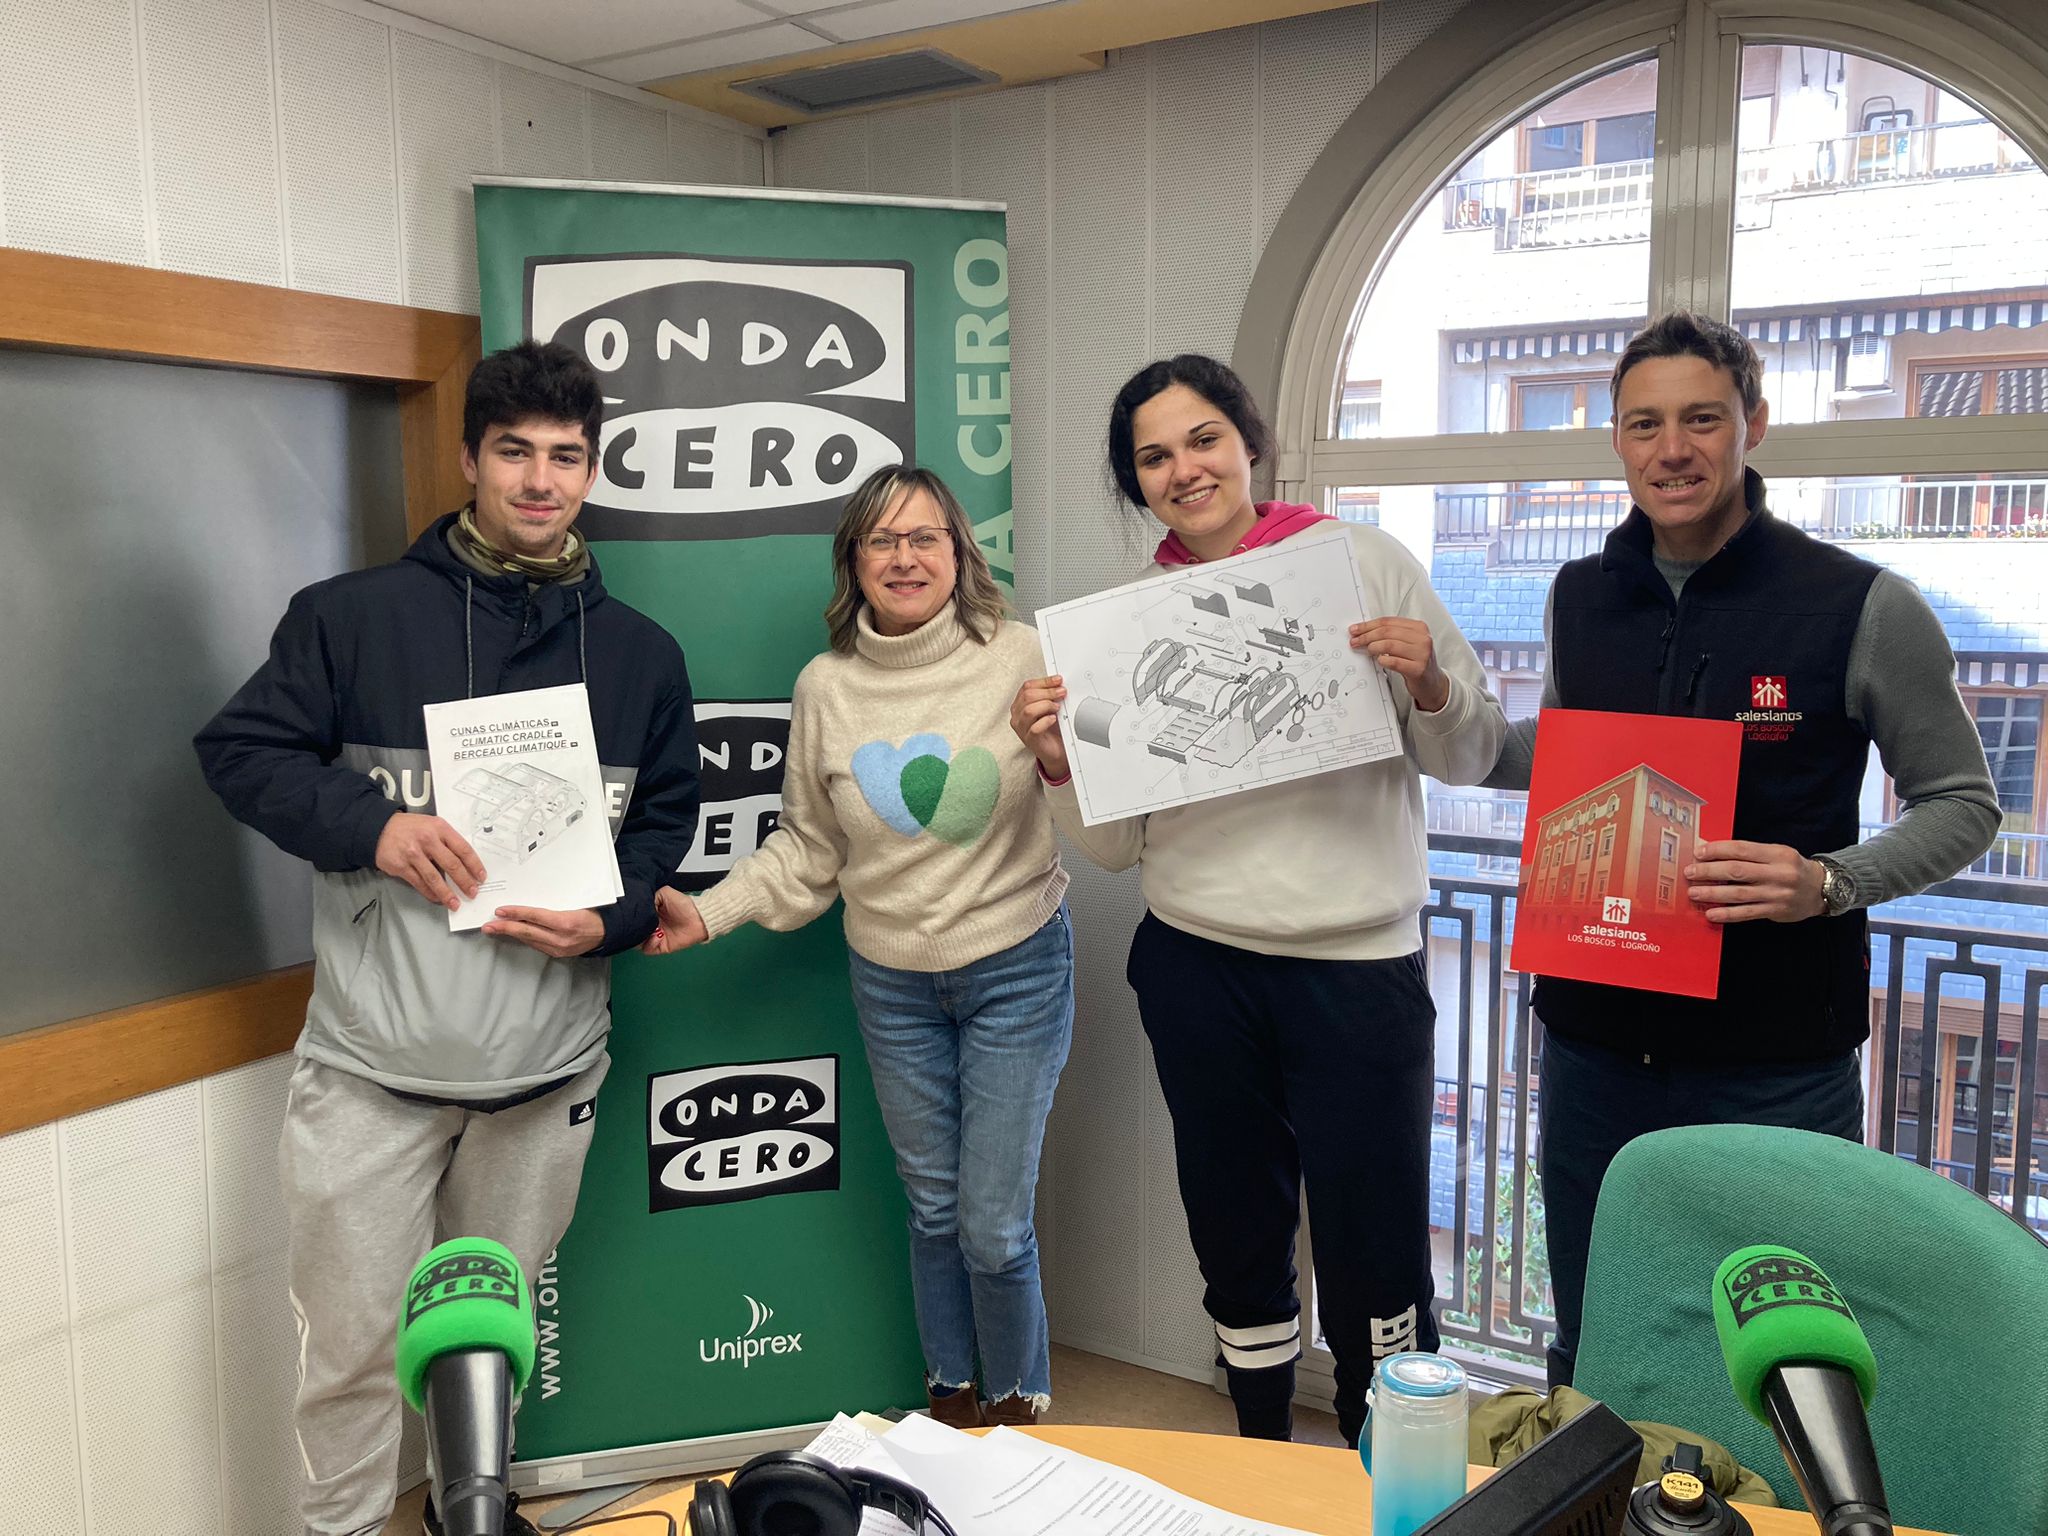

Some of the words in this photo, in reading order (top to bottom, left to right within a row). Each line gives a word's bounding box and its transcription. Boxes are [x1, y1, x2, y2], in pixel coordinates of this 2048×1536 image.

[584, 318, 853, 372] ONDA
[953, 238, 1011, 476] CERO
[602, 426, 858, 489] CERO
[1734, 709, 1803, 722] salesianos
[450, 724, 486, 737] CUNAS
[488, 718, 550, 732] CLIMÁTICAS
[461, 734, 510, 748] CLIMATIC
[512, 729, 553, 742] CRADLE
[454, 745, 504, 760] BERCEAU
[506, 739, 567, 754] CLIMATIQUE
[698, 741, 783, 771] ND
[1567, 933, 1583, 943] LOS
[1584, 936, 1617, 947] BOSCOS
[1621, 941, 1661, 953] LOGROÑO
[1582, 924, 1647, 941] salesianos
[676, 1088, 809, 1126] ONDA
[684, 1142, 811, 1171] CERO
[420, 1261, 503, 1286] ONDA
[1738, 1264, 1825, 1285] ONDA
[422, 1277, 504, 1302] CERO
[1750, 1284, 1834, 1303] CERO
[700, 1333, 802, 1368] Uniprex
[1667, 1479, 1698, 1489] K141
